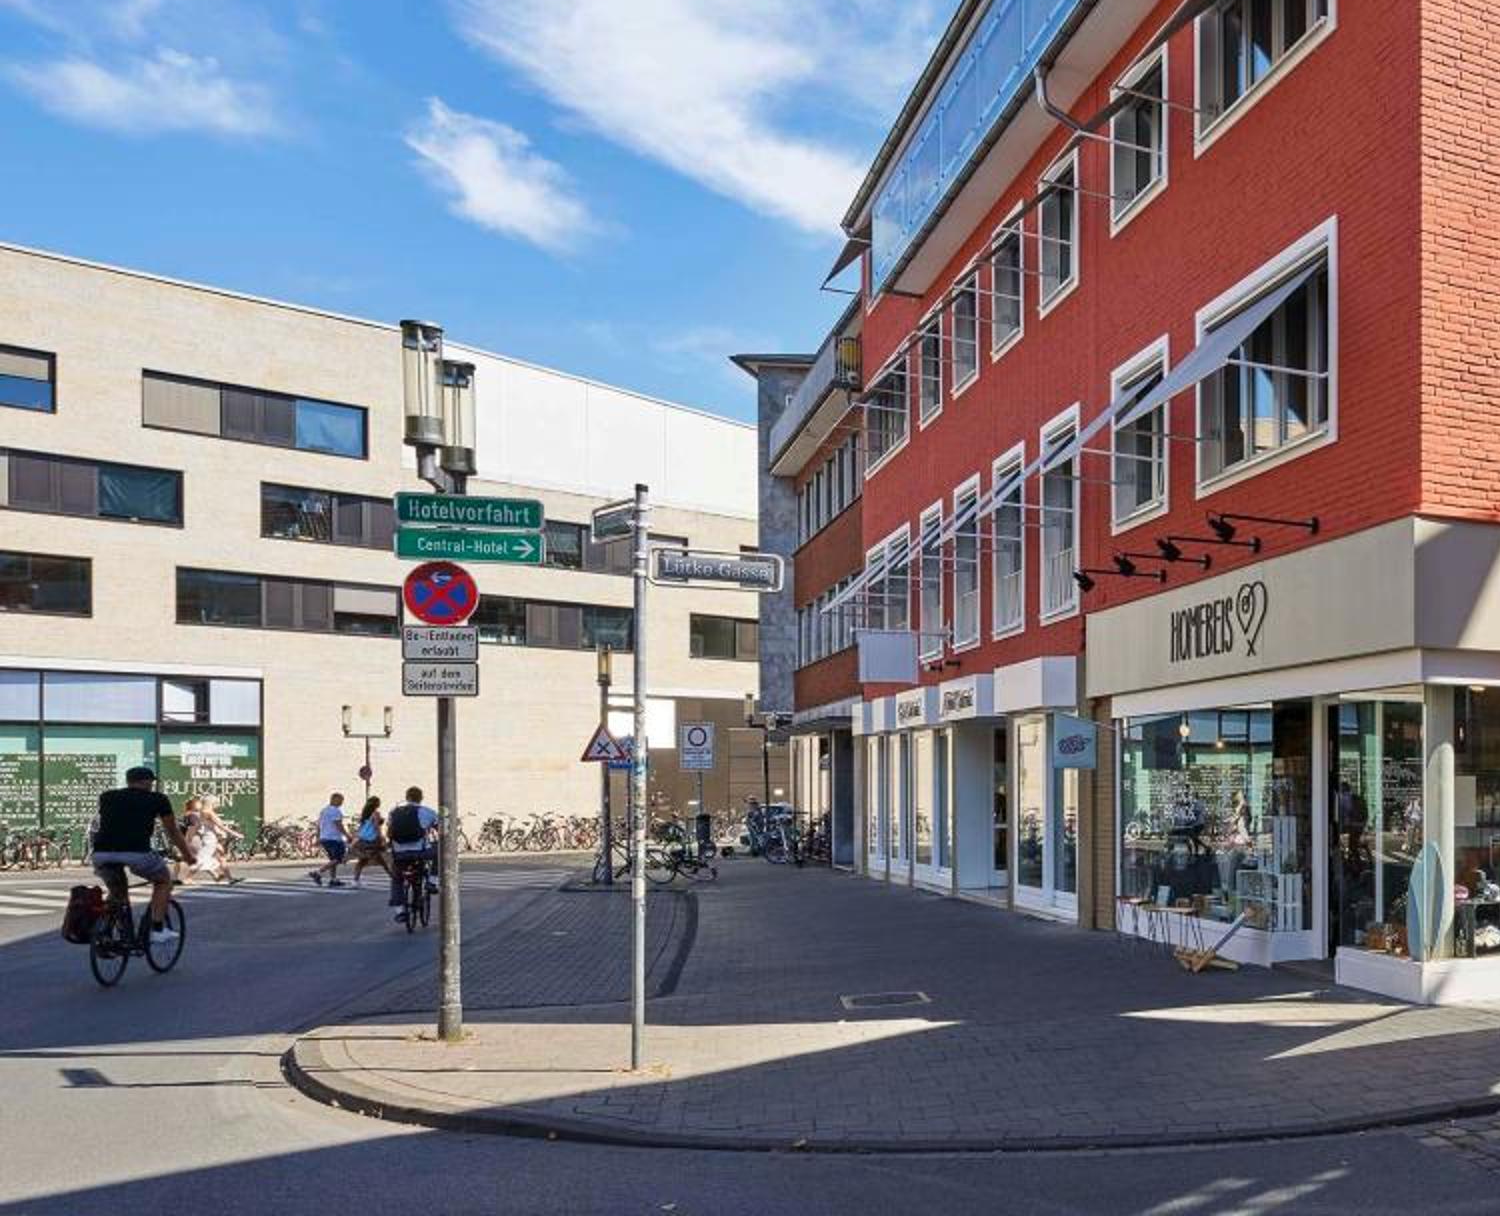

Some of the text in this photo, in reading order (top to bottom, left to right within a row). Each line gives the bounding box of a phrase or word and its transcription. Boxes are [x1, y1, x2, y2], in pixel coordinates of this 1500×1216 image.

[409, 499, 530, 523] Hotelvorfahrt
[417, 537, 508, 554] Central-Hotel
[1170, 596, 1233, 664] HOMEBEIS
[421, 645, 459, 657] erlaubt
